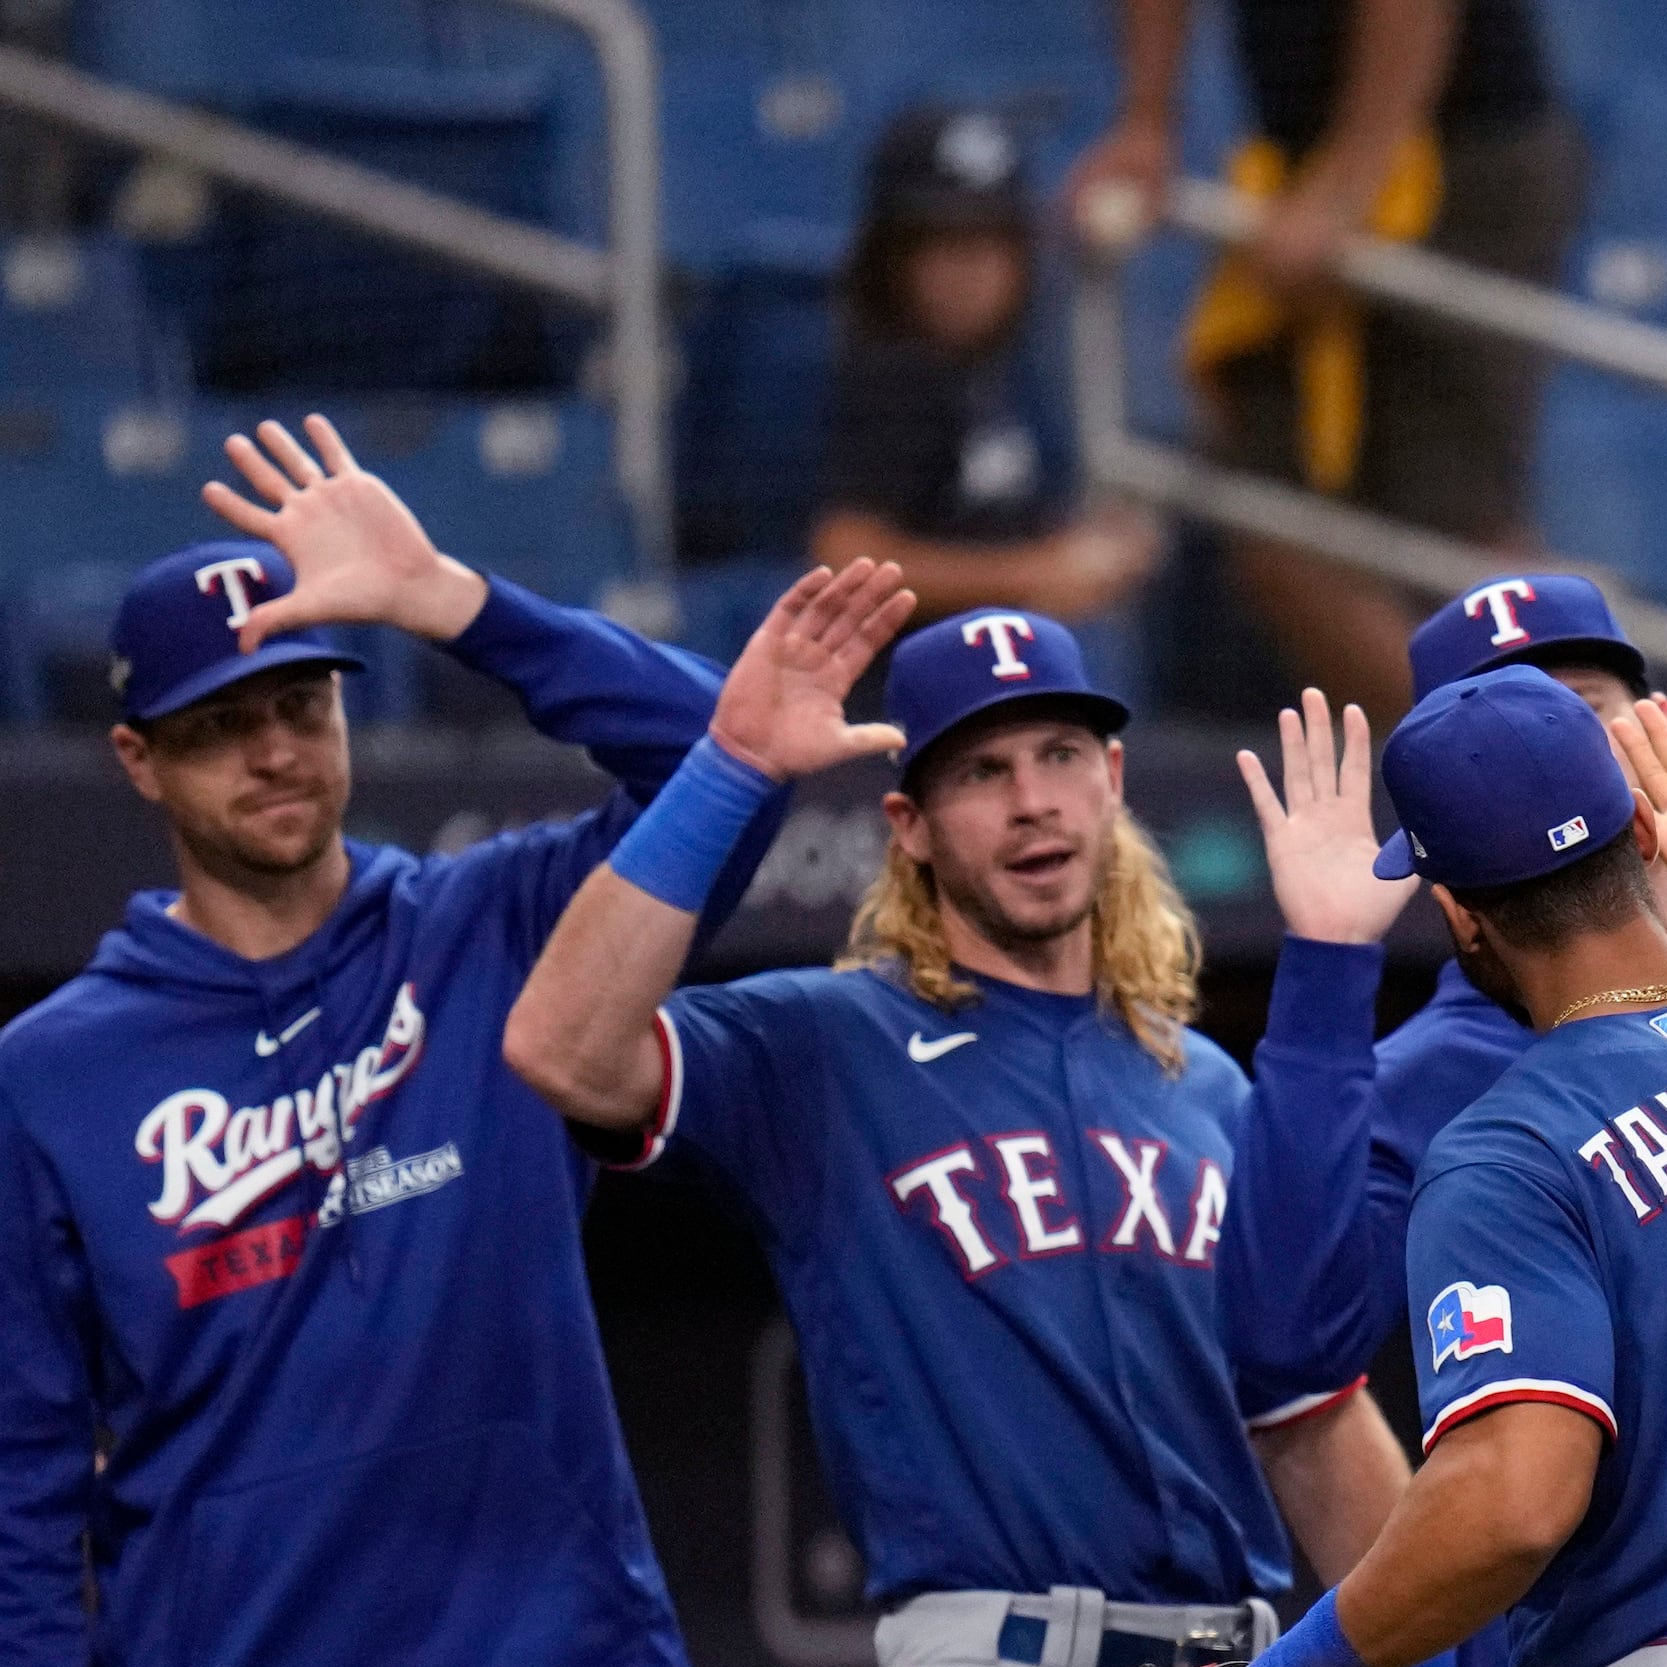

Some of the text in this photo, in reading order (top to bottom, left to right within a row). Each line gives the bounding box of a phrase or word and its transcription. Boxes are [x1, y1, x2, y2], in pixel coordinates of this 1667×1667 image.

[195, 557, 267, 630] T
[1464, 579, 1536, 648] T
[962, 615, 1035, 680] T
[135, 981, 425, 1224] Ranges
[885, 1130, 1228, 1282] TEXA
[202, 1233, 301, 1283] TEXA
